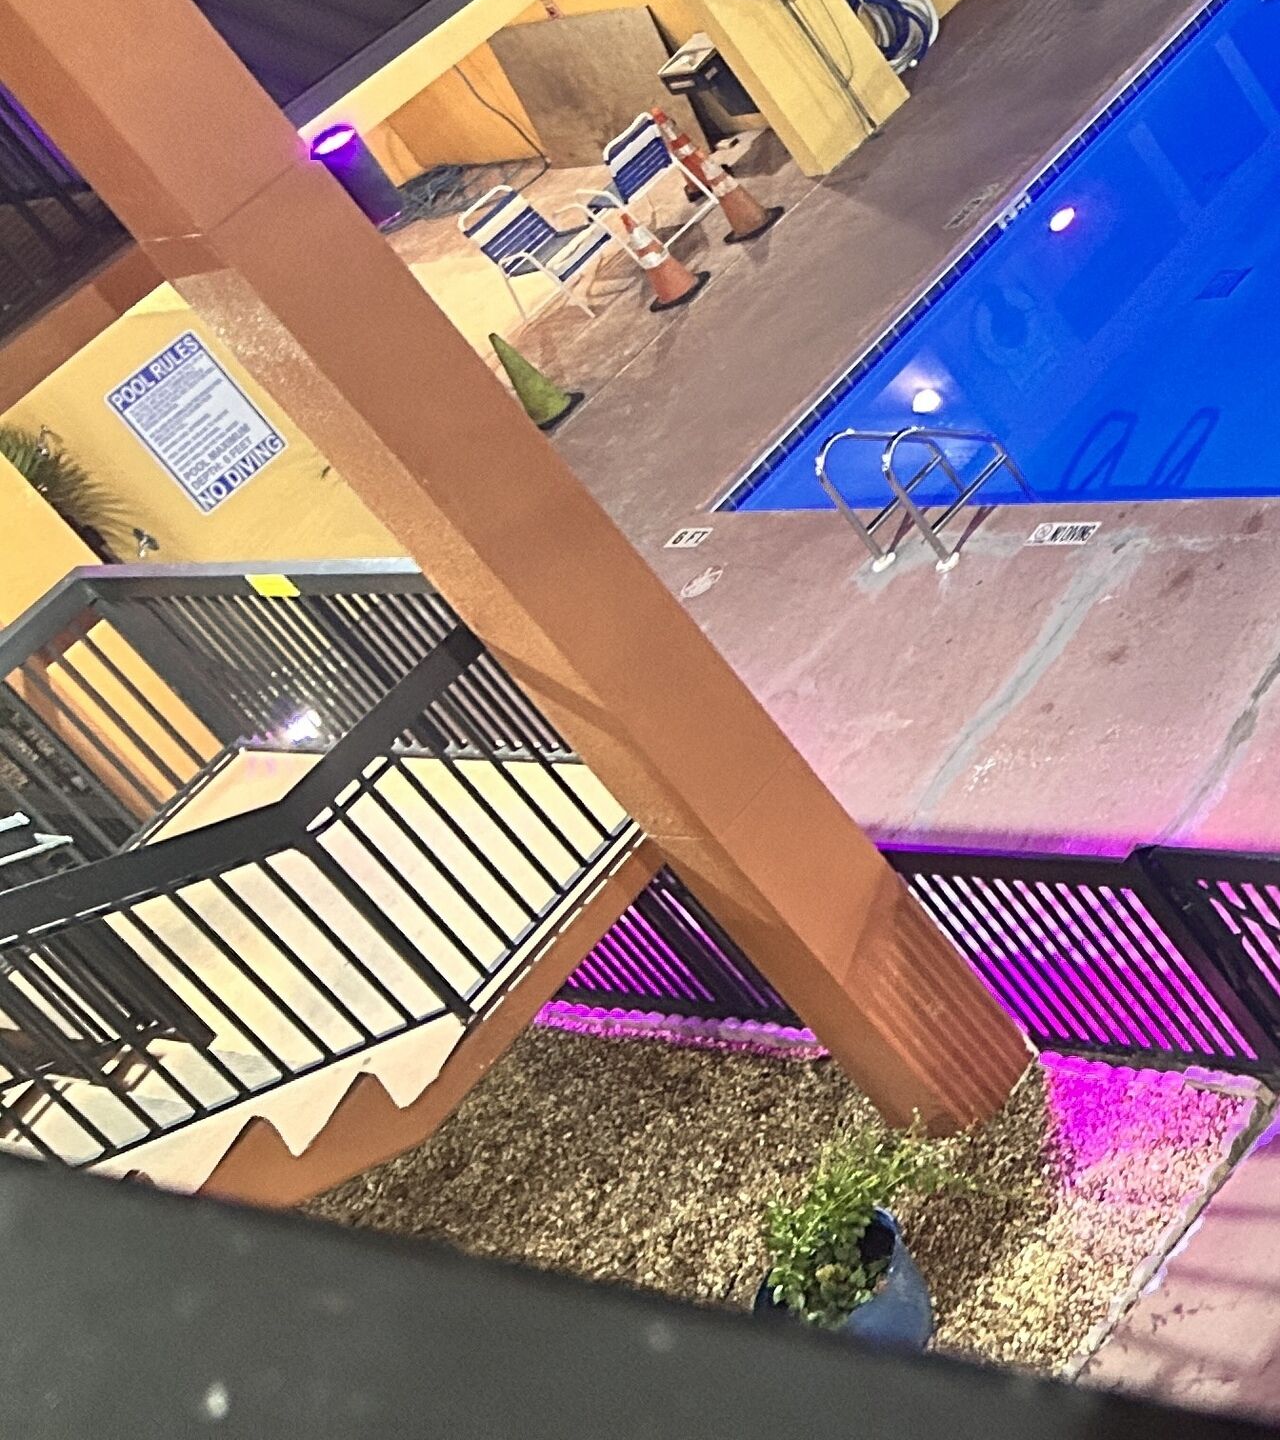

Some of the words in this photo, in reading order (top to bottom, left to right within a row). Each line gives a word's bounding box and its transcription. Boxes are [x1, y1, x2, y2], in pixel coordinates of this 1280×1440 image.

[111, 372, 156, 411] POOL
[149, 335, 199, 380] RULES
[183, 456, 210, 482] POOL
[198, 480, 228, 510] NO
[223, 433, 284, 486] DIVING
[671, 530, 688, 545] 6
[684, 530, 709, 545] FT
